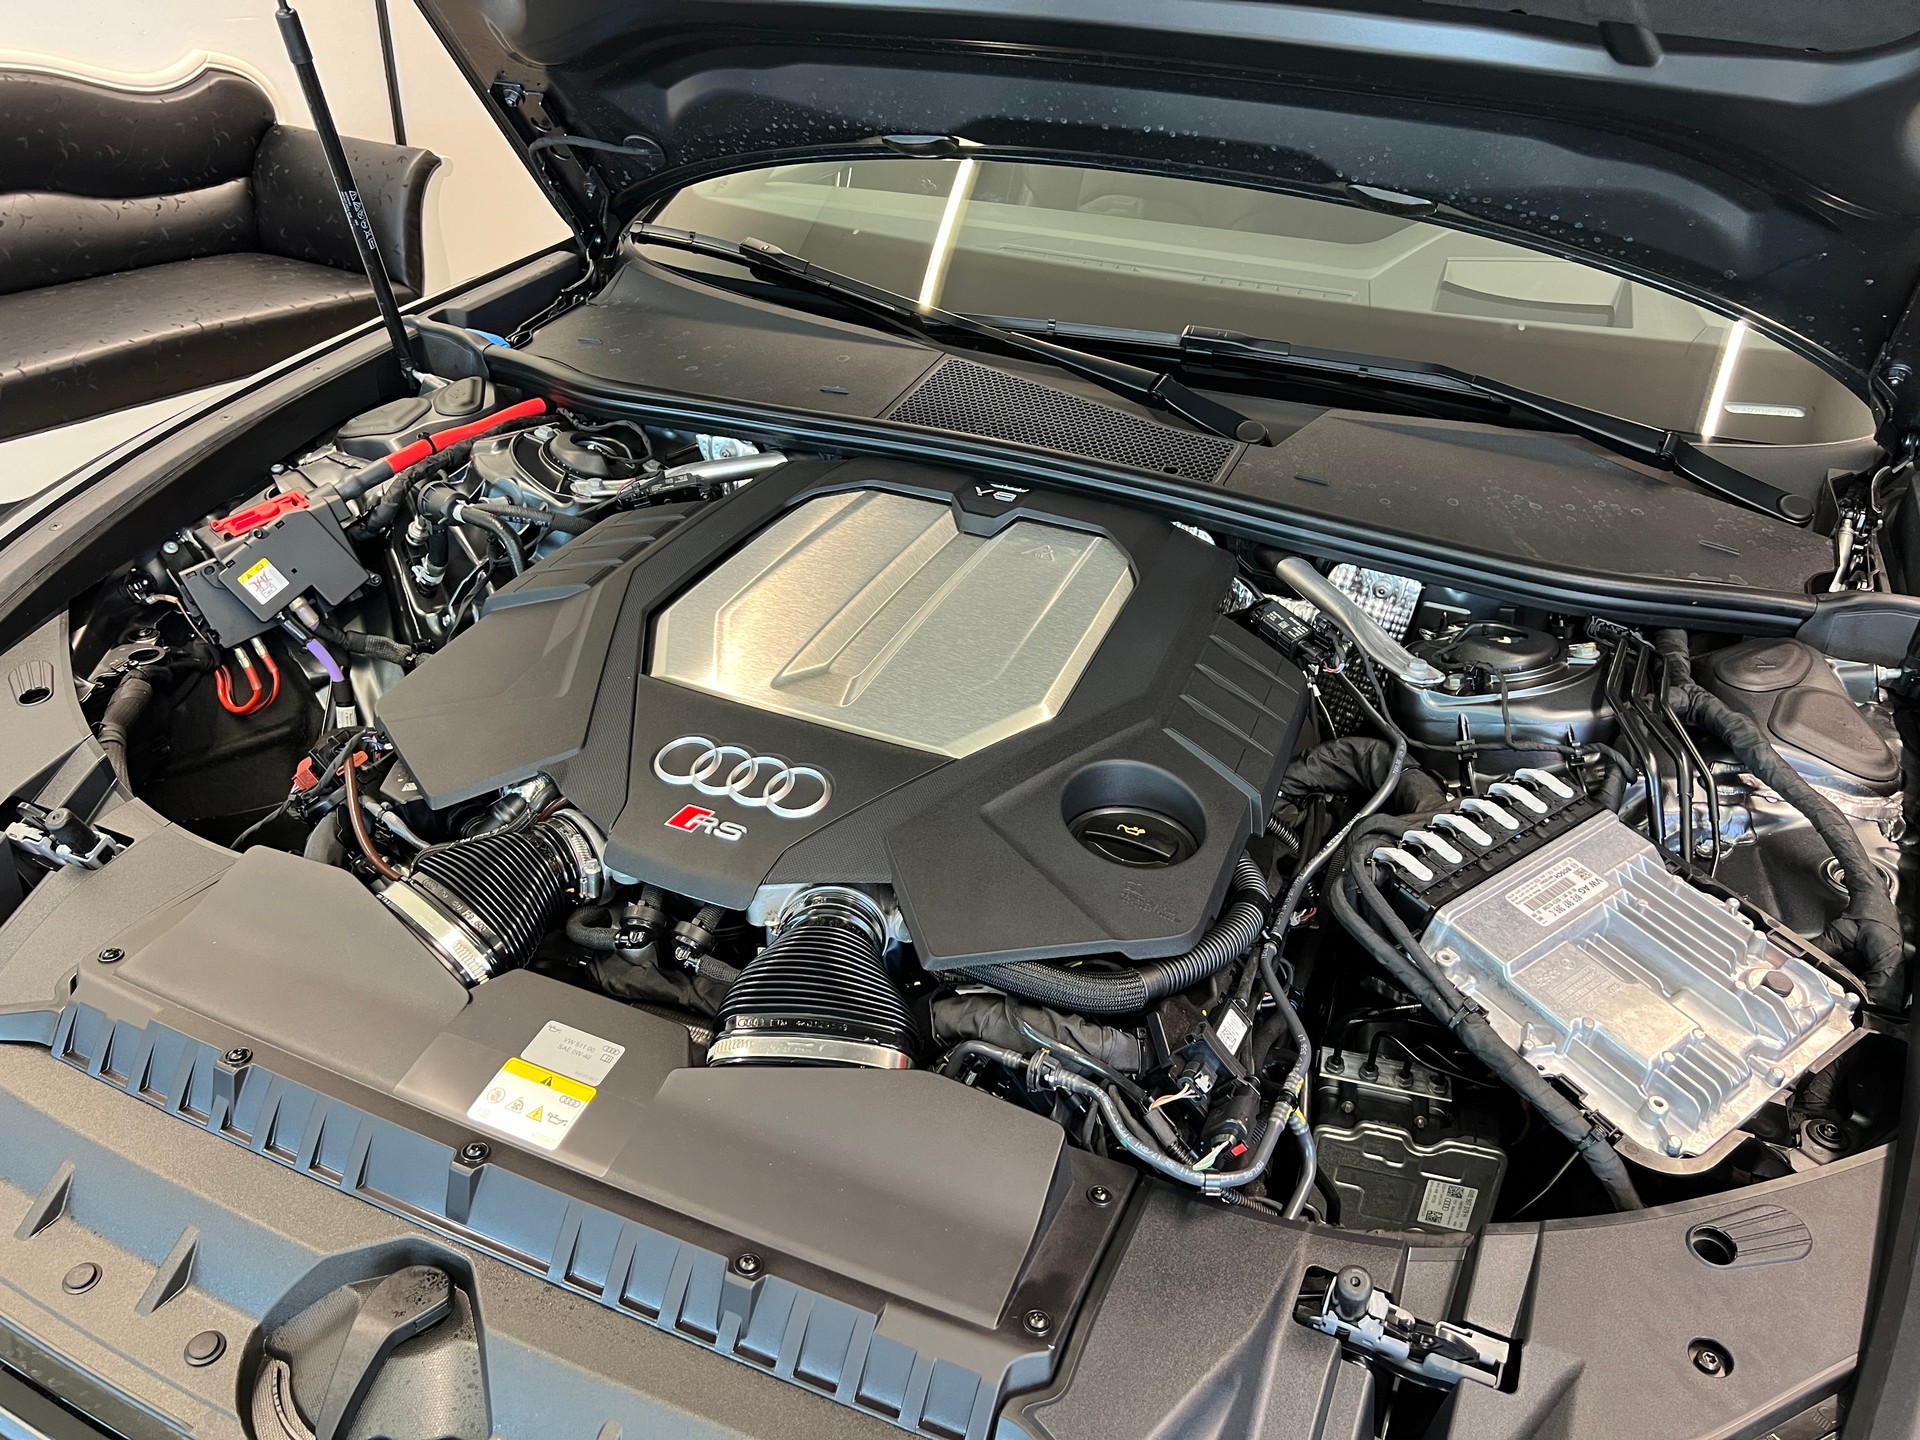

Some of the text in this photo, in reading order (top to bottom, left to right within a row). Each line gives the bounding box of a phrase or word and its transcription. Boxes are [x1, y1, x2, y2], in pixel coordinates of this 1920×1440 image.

[676, 810, 748, 842] RS
[1578, 877, 1603, 895] VW AG
[563, 1036, 576, 1045] VW
[575, 1041, 587, 1049] 511
[557, 1044, 592, 1060] SAE 0W-40
